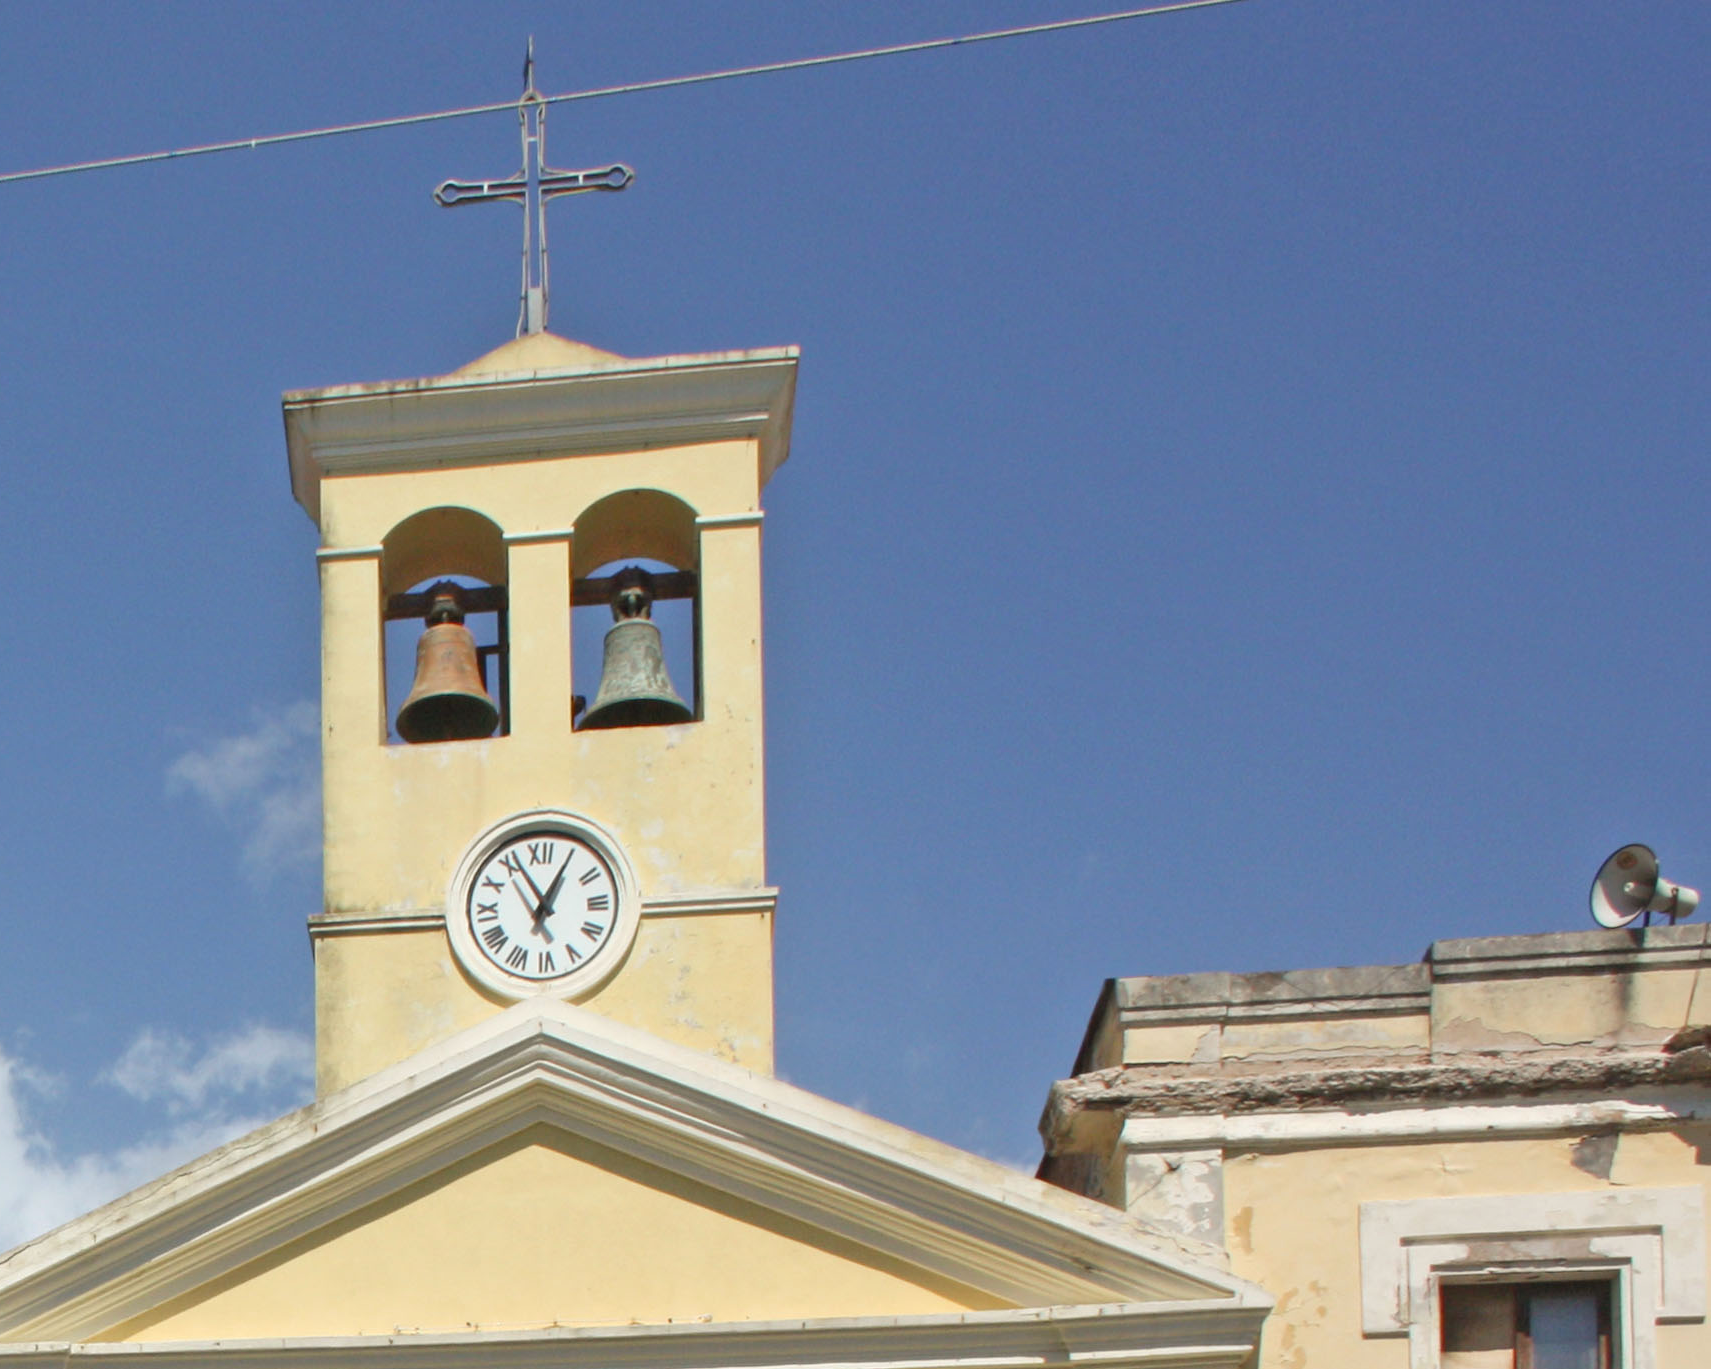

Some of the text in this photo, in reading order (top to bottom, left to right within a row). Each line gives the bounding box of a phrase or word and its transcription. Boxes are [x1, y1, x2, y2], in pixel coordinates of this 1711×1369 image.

[527, 842, 555, 867] XII
[481, 875, 506, 895] X
[578, 866, 601, 887] II
[476, 901, 499, 923] IX
[586, 894, 610, 912] III
[481, 924, 509, 956] VIII
[580, 921, 605, 943] IV
[505, 944, 529, 972] VII
[538, 950, 556, 974] VI
[565, 943, 583, 965] V
